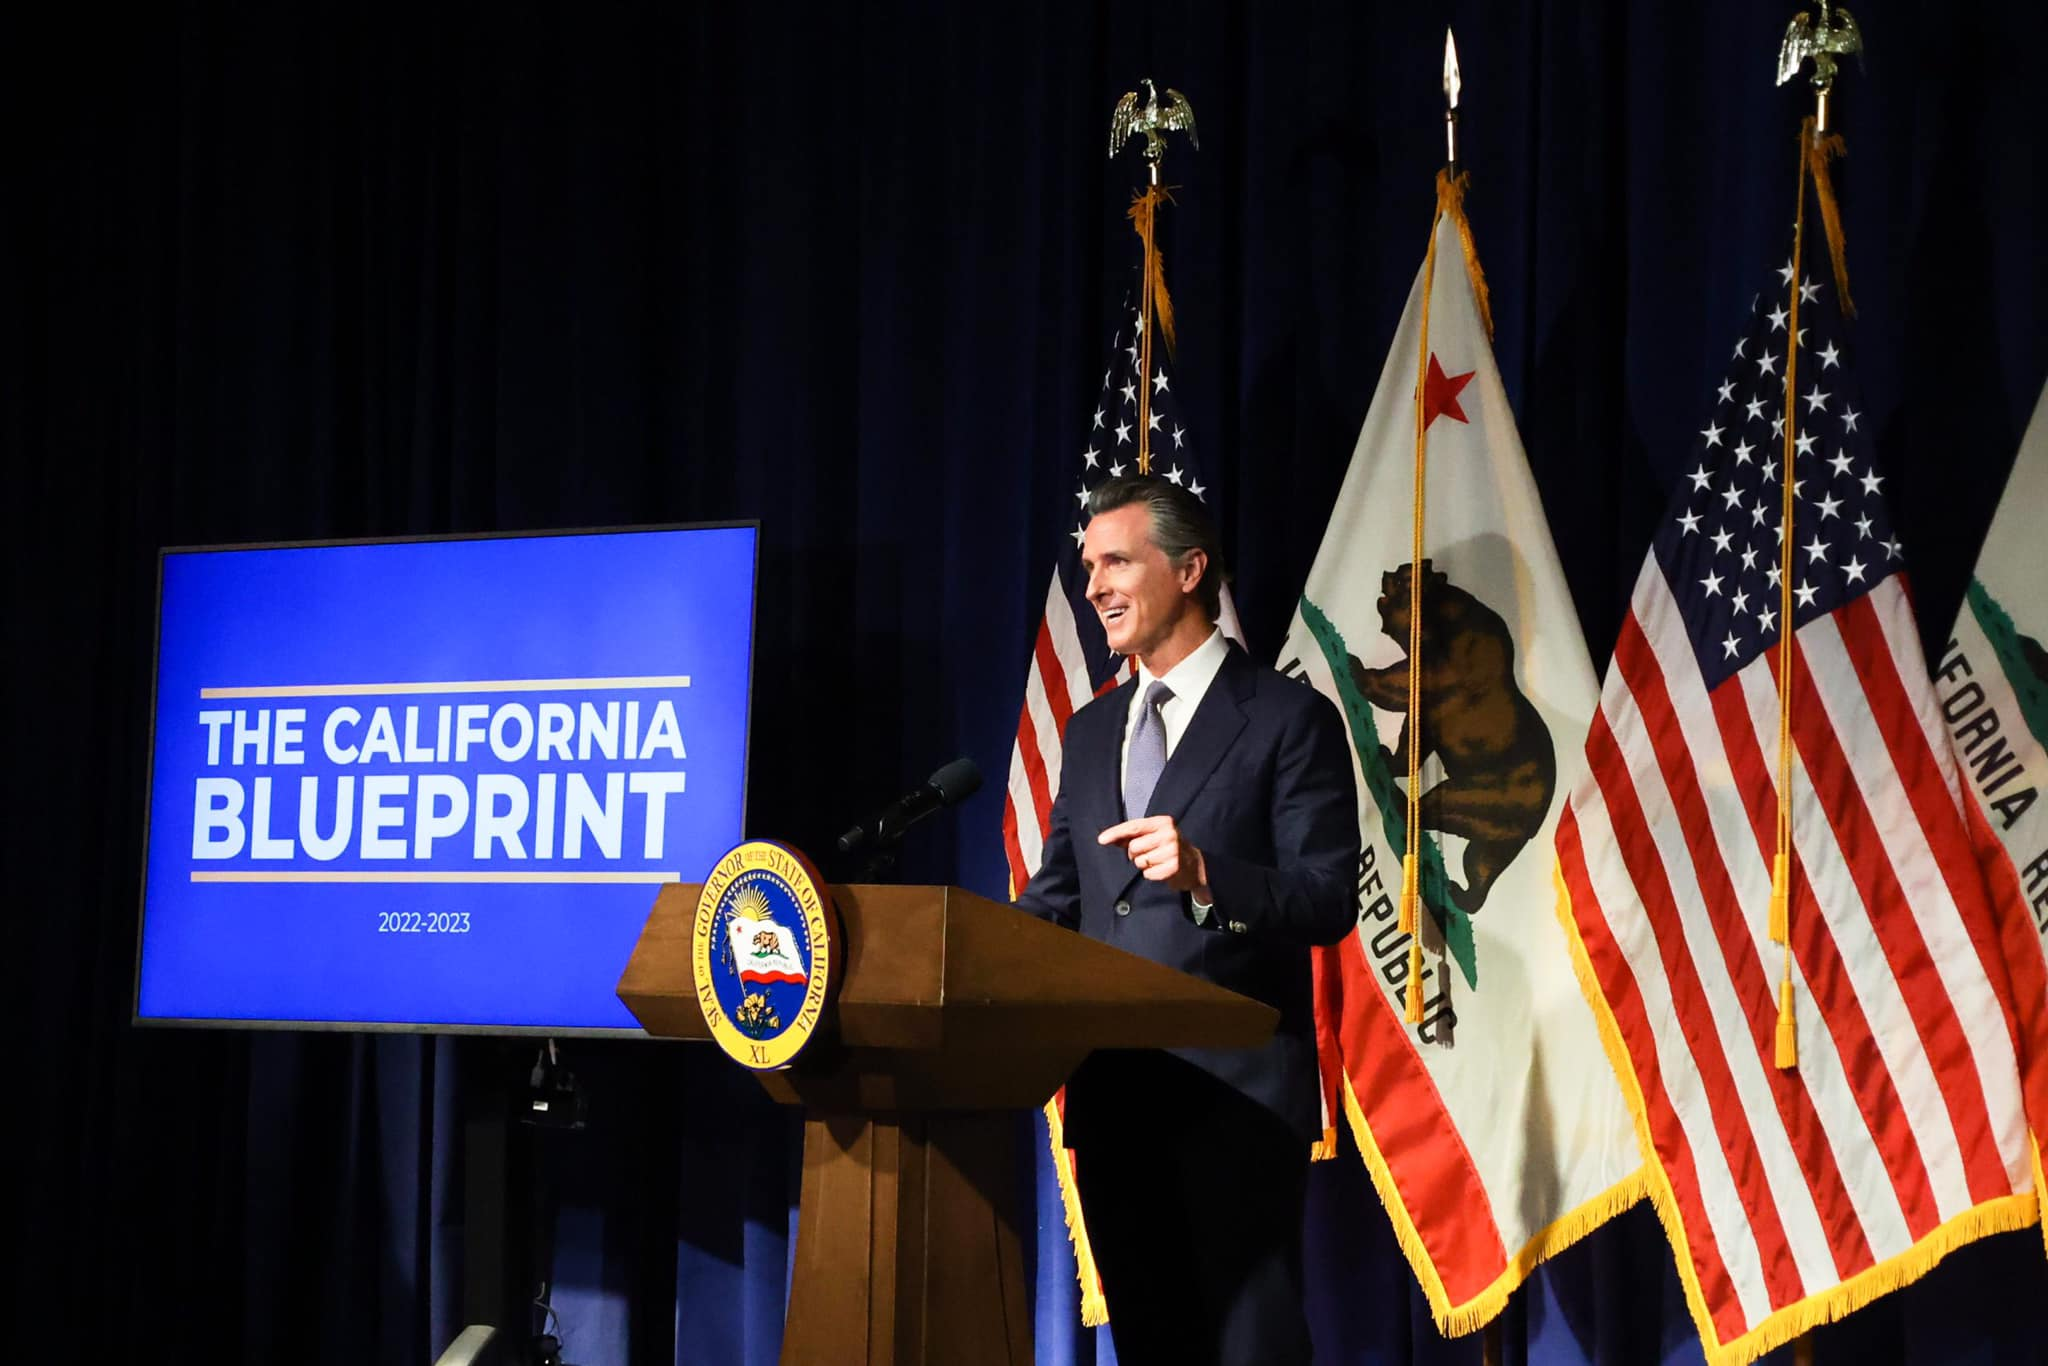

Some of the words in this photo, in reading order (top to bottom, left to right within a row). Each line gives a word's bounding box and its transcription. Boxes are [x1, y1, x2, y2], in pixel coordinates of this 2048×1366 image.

[199, 708, 306, 766] THE
[322, 700, 687, 765] CALIFORNIA
[191, 771, 687, 861] BLUEPRINT
[768, 849, 805, 892] STATE
[697, 852, 745, 938] GOVERNOR
[802, 887, 818, 911] OF
[378, 911, 471, 933] 2022-2023
[797, 917, 826, 1032] CALIFORNIA
[700, 985, 722, 1028] SEAL
[749, 1044, 771, 1064] XL
